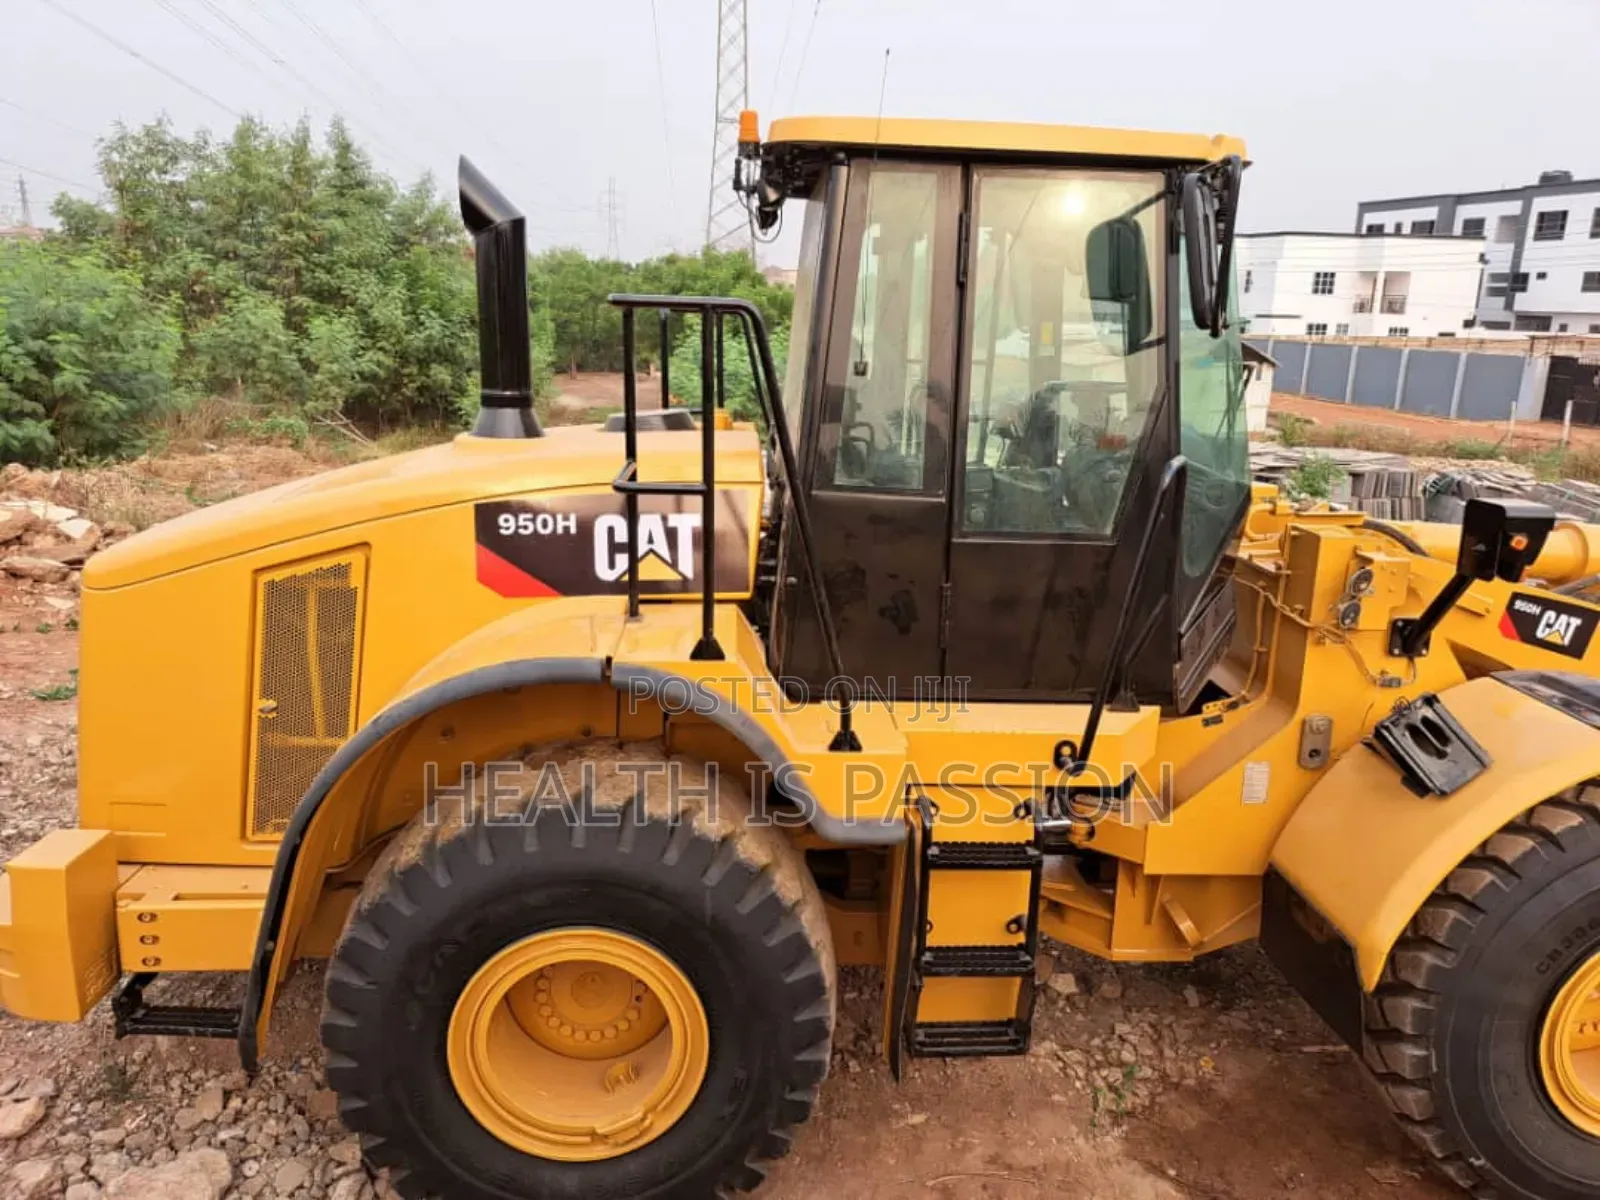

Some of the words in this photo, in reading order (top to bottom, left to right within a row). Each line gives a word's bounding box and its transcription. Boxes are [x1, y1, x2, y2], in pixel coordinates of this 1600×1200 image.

[498, 512, 577, 536] 950H
[593, 513, 703, 582] CAT
[1535, 610, 1583, 647] CAT
